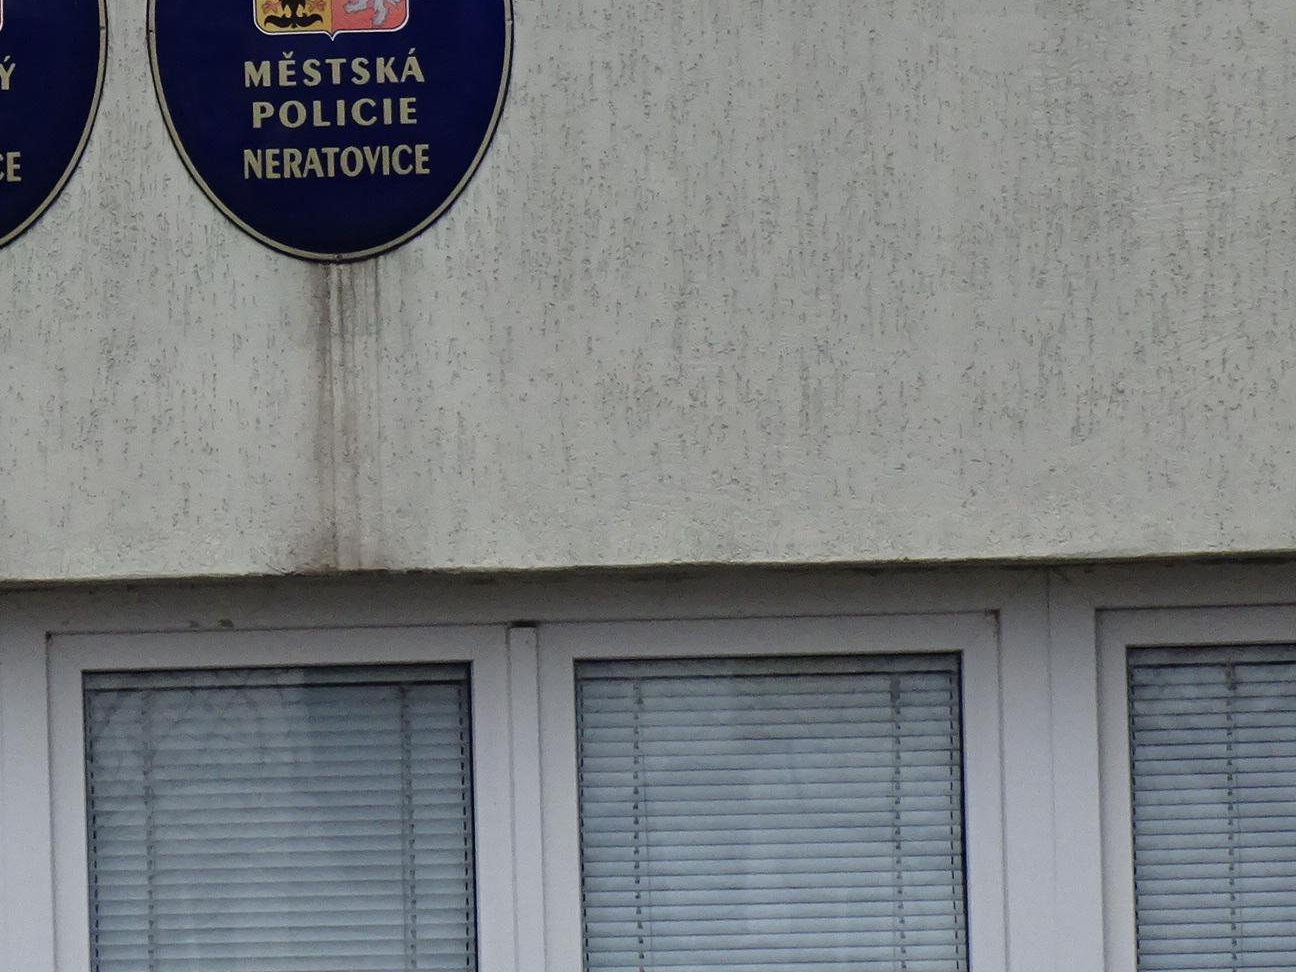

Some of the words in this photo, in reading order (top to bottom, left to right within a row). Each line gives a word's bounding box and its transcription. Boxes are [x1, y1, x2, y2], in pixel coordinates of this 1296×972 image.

[243, 47, 425, 88] MĚSTSKÁ
[252, 97, 418, 129] POLICIE
[243, 143, 431, 180] NERATOVICE
